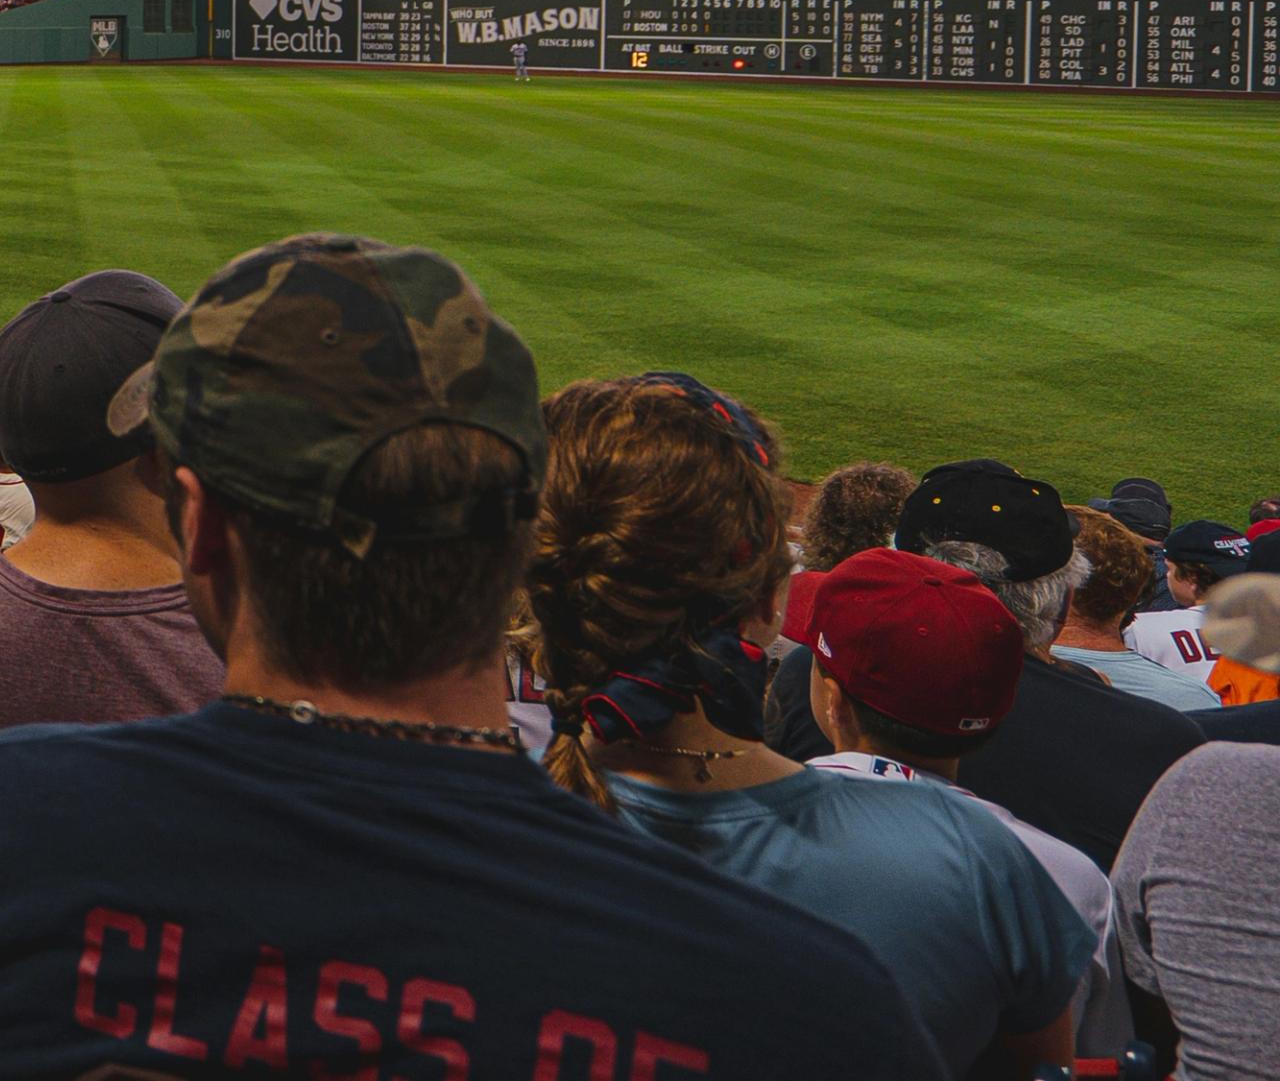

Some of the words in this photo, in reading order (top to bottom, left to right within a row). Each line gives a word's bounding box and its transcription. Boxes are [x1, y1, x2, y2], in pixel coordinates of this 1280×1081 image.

[451, 9, 473, 18] WHO
[475, 9, 494, 18] BUT
[641, 10, 661, 19] HOU
[955, 14, 972, 23] KC
[1060, 15, 1086, 24] CHC
[1173, 16, 1195, 26] ARI
[93, 21, 116, 31] MLB
[634, 23, 668, 32] BOSTON
[860, 24, 882, 32] BAL
[952, 25, 974, 33] LAA
[1065, 26, 1081, 35] SD
[216, 29, 231, 39] 310
[1170, 28, 1196, 37] OAK
[252, 24, 343, 53] Health
[539, 38, 570, 47] SINCE
[571, 38, 595, 47] 1898
[861, 34, 882, 42] SEA
[952, 36, 974, 44] NYY
[1060, 37, 1085, 47] LAD
[622, 43, 633, 52] AT
[659, 44, 683, 53] BALL
[860, 44, 882, 53] DET
[1171, 39, 1194, 49] MIL
[693, 44, 729, 54] STRIKE
[732, 46, 756, 55] OUT
[952, 46, 973, 55] MIN
[1062, 48, 1082, 57] PIT
[631, 52, 648, 68] 12
[859, 55, 883, 63] WSH
[1171, 51, 1194, 60] CIN
[952, 57, 974, 66] TOR
[1059, 60, 1084, 69] COL
[864, 65, 878, 73] TB
[950, 68, 974, 76] CWS
[1170, 63, 1194, 73] ATL
[1061, 71, 1082, 80] MIA
[1171, 74, 1193, 84] PHI
[74, 906, 477, 1081] CLASS
